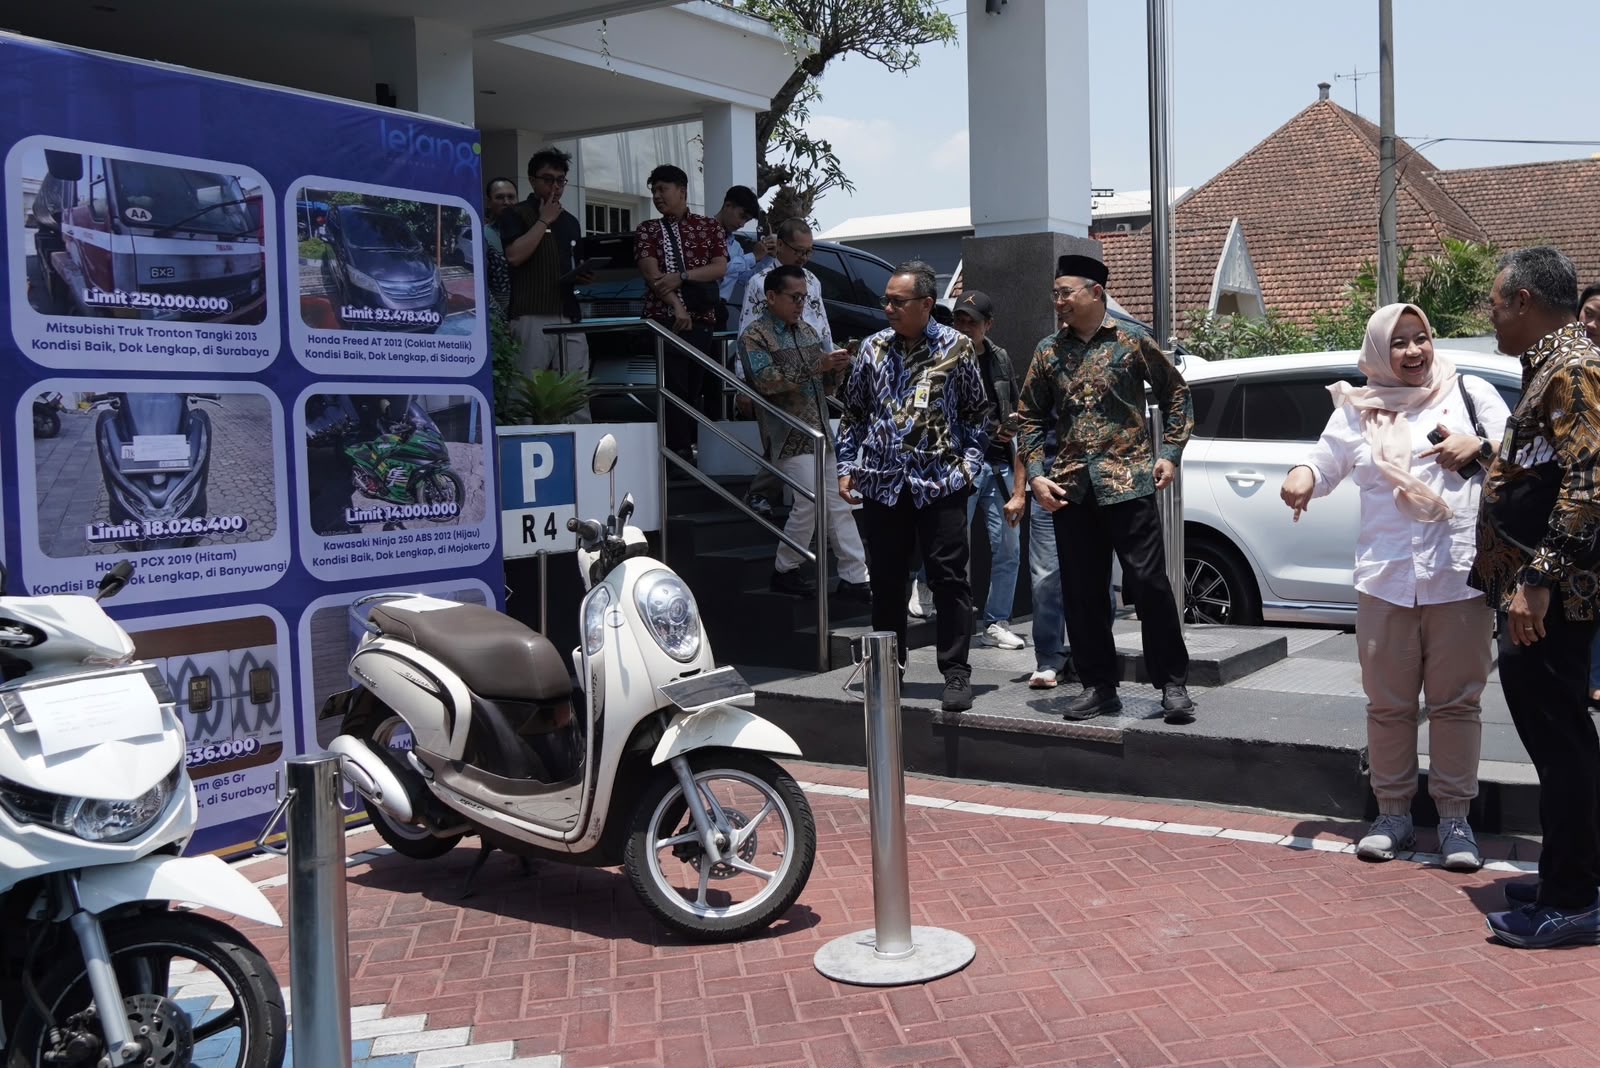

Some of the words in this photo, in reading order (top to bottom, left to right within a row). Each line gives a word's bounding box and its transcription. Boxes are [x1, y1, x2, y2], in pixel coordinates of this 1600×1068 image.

[130, 210, 149, 221] AA
[83, 288, 128, 305] Limit
[131, 291, 229, 311] 250.000.000
[341, 306, 373, 320] Limit
[376, 310, 440, 324] 93.478.400
[46, 322, 115, 336] Mitsubishi
[117, 325, 144, 337] Truk
[146, 327, 193, 339] Tronton
[195, 329, 232, 342] Tangki
[234, 331, 257, 341] 2013
[308, 334, 341, 346] Honda
[343, 336, 369, 346] Freed
[371, 338, 382, 346] AT
[383, 338, 403, 347] 2012
[404, 338, 436, 349] (Coklat
[437, 340, 472, 351] Metalik)
[31, 339, 81, 352] Kondisi
[84, 341, 116, 354] Baik,
[119, 342, 143, 353] Dok
[146, 343, 200, 356] Lengkap,
[203, 345, 214, 356] di
[216, 346, 270, 358] Surabaya
[305, 349, 341, 360] Kondisi
[343, 351, 367, 361] Baik,
[368, 352, 386, 361] Dok
[388, 352, 429, 363] Lengkap,
[430, 354, 439, 362] di
[440, 355, 476, 364] Sidoarjo
[520, 441, 554, 503] P
[346, 505, 383, 523] Limit
[385, 502, 457, 519] 14.000.000
[86, 518, 140, 541] Limit
[143, 515, 243, 537] 18.026.400
[323, 537, 370, 551] Kawasaki
[372, 536, 396, 547] Ninja
[398, 535, 413, 544] 250
[415, 533, 433, 543] ABS
[434, 532, 451, 542] 2012
[453, 528, 480, 541] (Hijau)
[95, 560, 138, 572] Hoa
[141, 554, 165, 568] PCX
[168, 553, 193, 566] 2019
[195, 549, 237, 565] (Hitam)
[312, 555, 349, 567] Kondisi
[351, 553, 374, 563] Baik,
[376, 551, 394, 560] Dok
[395, 547, 436, 559] Lengkap,
[438, 545, 447, 554] di
[448, 542, 490, 554] Mojokerto
[33, 579, 83, 596] Kondisi
[130, 574, 145, 585] ok
[148, 567, 203, 584] Lengkap,
[206, 568, 218, 578] di
[219, 560, 288, 577] Banyuwangi
[212, 776, 230, 789] @5
[232, 773, 246, 783] Gr
[207, 794, 218, 805] di
[221, 782, 276, 802] Surabaya
